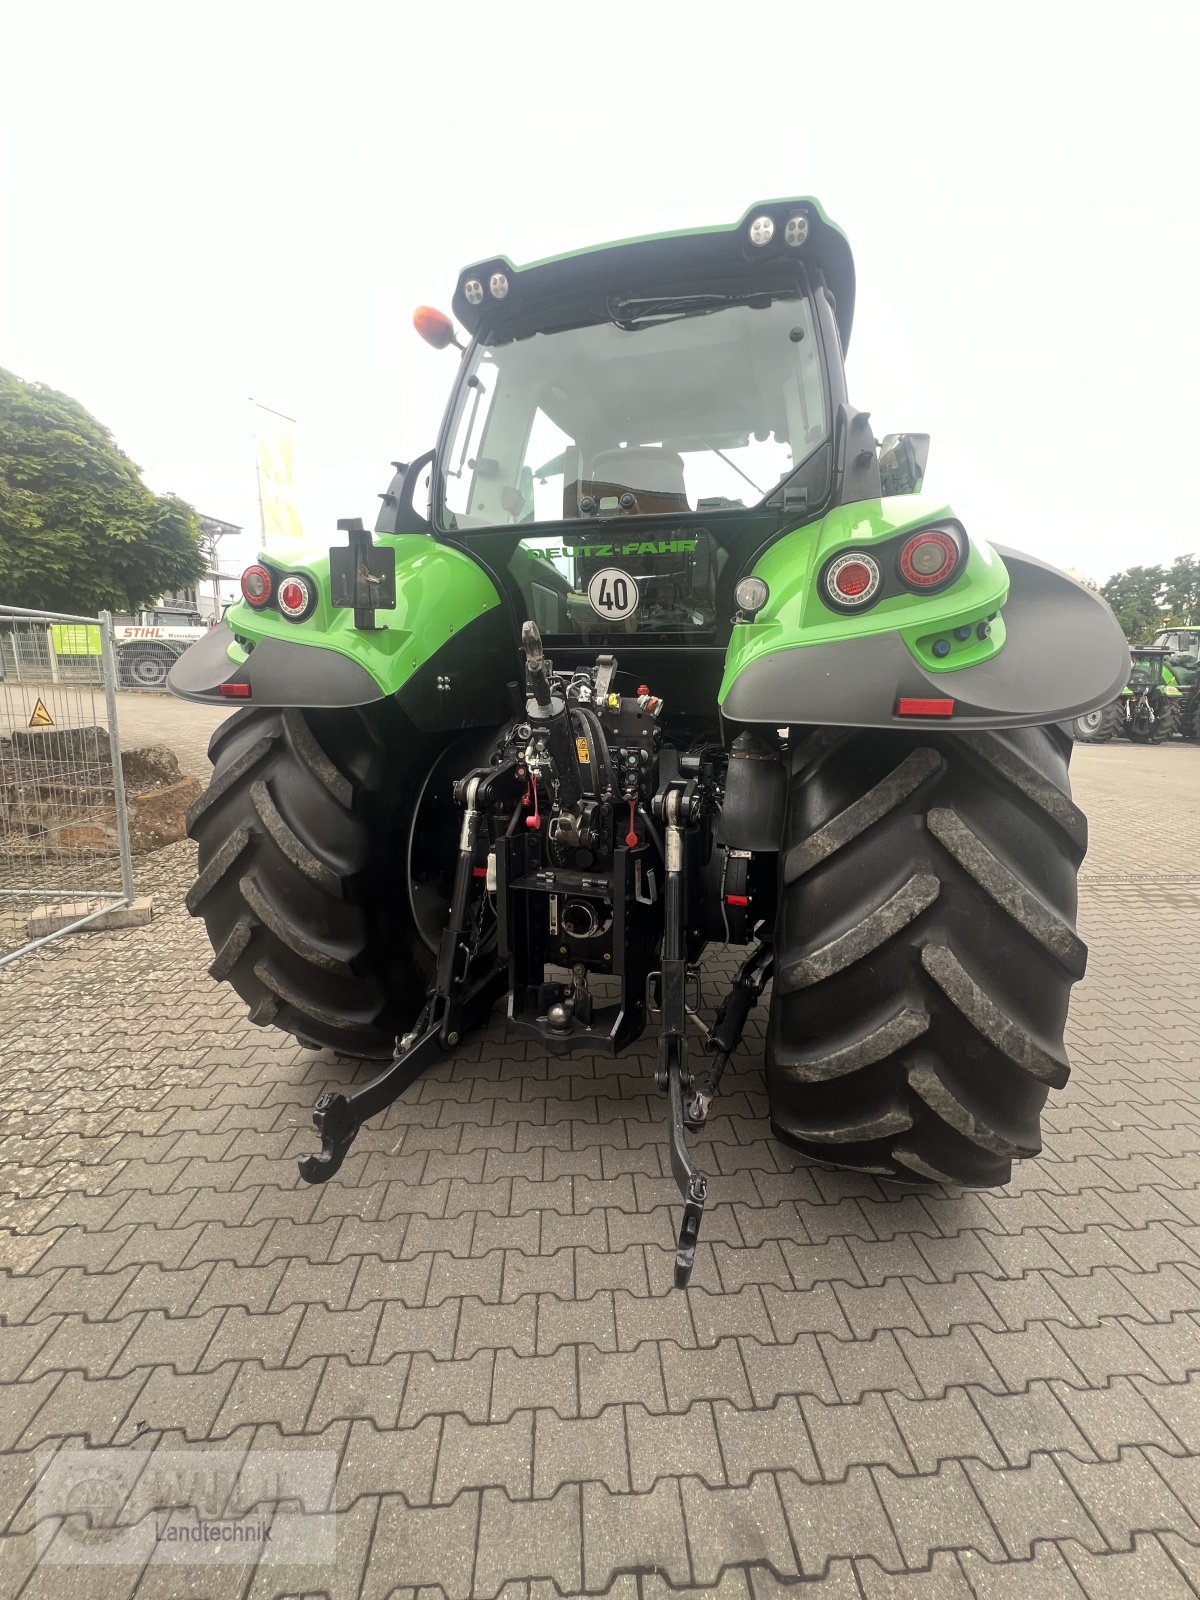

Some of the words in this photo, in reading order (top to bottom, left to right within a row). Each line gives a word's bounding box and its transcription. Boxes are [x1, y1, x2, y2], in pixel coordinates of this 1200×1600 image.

[527, 539, 697, 560] DEUTZ-FAHR
[598, 577, 628, 611] 40
[123, 627, 163, 638] STIHL
